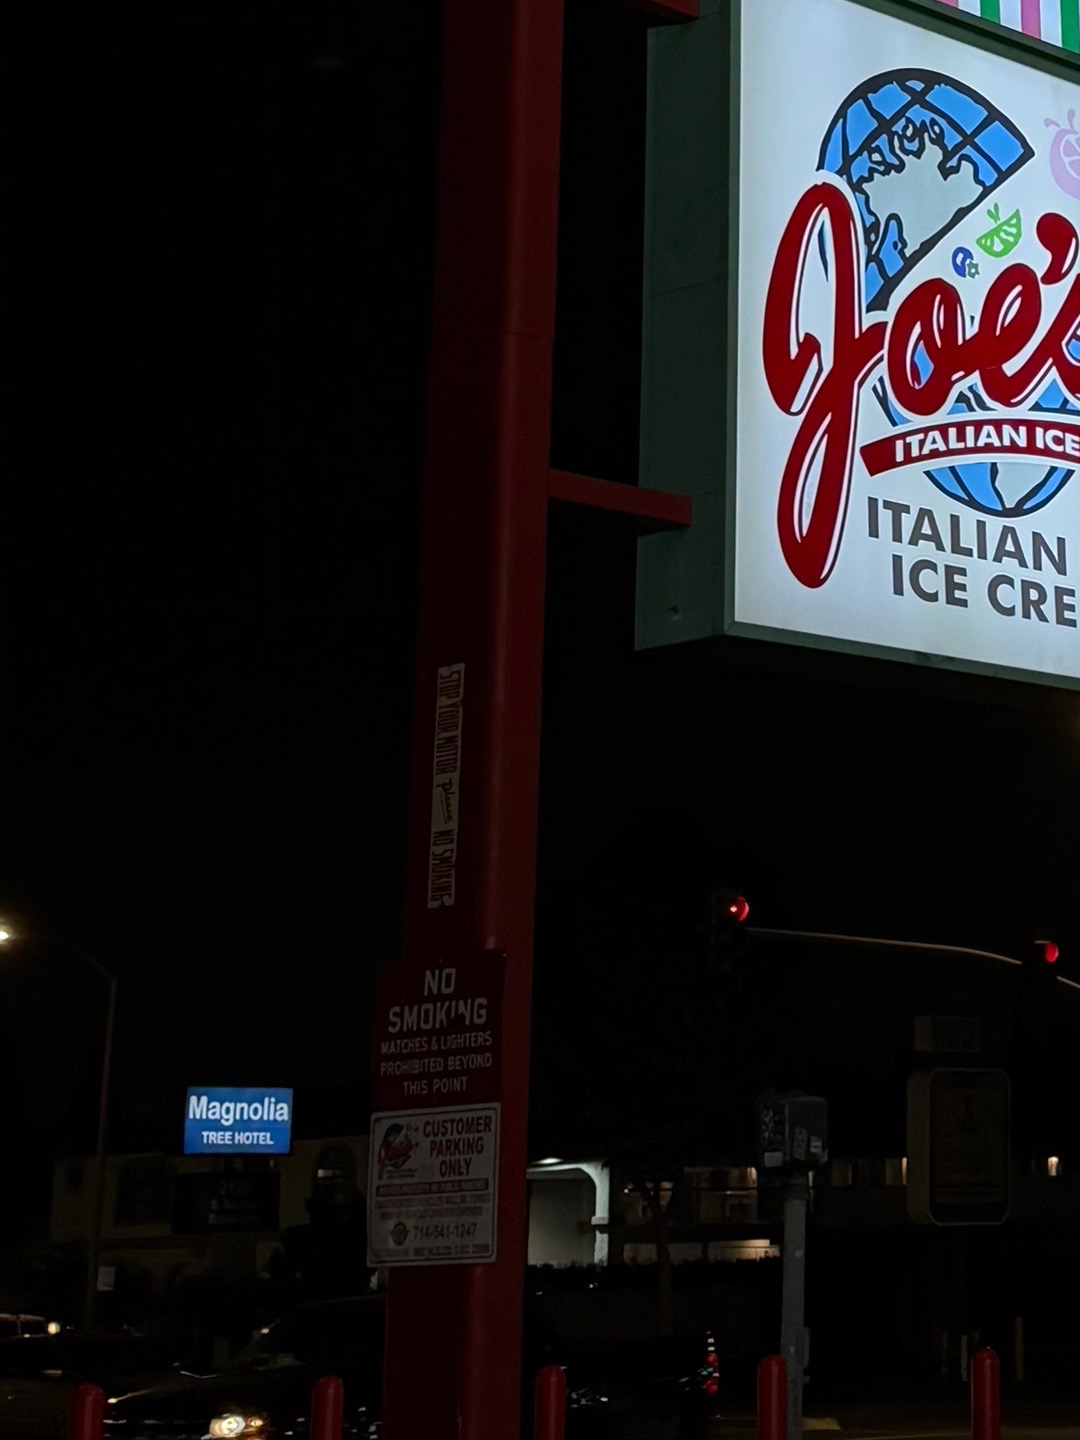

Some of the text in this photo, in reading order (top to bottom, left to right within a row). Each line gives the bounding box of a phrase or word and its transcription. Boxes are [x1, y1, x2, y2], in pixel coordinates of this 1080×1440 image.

[895, 424, 1028, 463] ITALIAN
[867, 496, 1067, 578] ITALIAN
[891, 554, 969, 610] ICE
[430, 670, 462, 902] STOP YOUR MOTOR please NO SMOKING
[424, 967, 456, 996] NO
[387, 997, 488, 1034] SMOKING
[381, 1030, 493, 1054] MATCHES & LIGHTERS
[380, 1053, 493, 1076] PROHIBITED BEYOND
[403, 1076, 469, 1096] THIS POINT
[188, 1095, 289, 1126] Magnolia
[201, 1130, 274, 1145] TREE HOTEL
[423, 1115, 492, 1138] CUSTOMER
[430, 1137, 485, 1157] PARKING
[439, 1157, 473, 1178] ONLY
